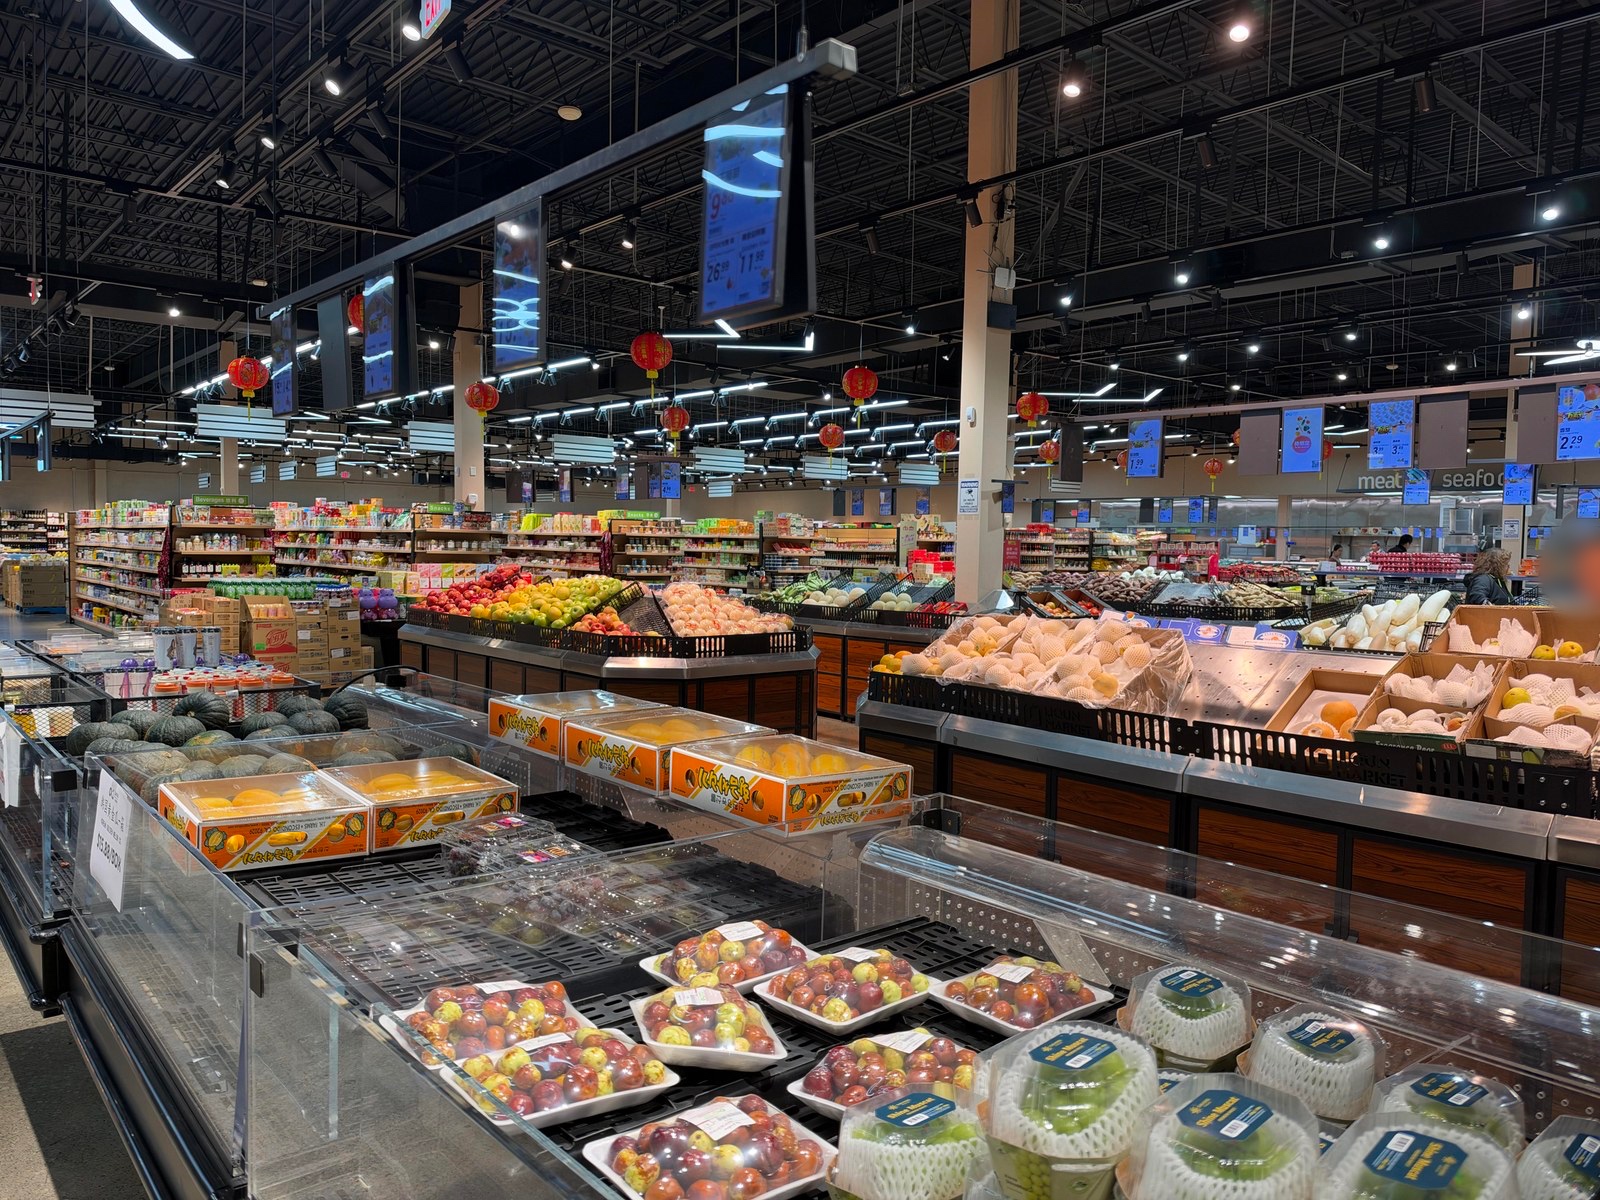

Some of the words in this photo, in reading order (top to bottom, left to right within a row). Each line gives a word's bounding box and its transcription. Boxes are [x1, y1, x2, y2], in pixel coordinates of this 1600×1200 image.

[1560, 435, 1583, 449] 2.29
[1358, 473, 1402, 489] meat
[195, 496, 224, 504] Beverages
[698, 766, 750, 804] 황금싸라기
[1196, 1112, 1219, 1128] Shine
[1212, 1096, 1240, 1114] Muscat
